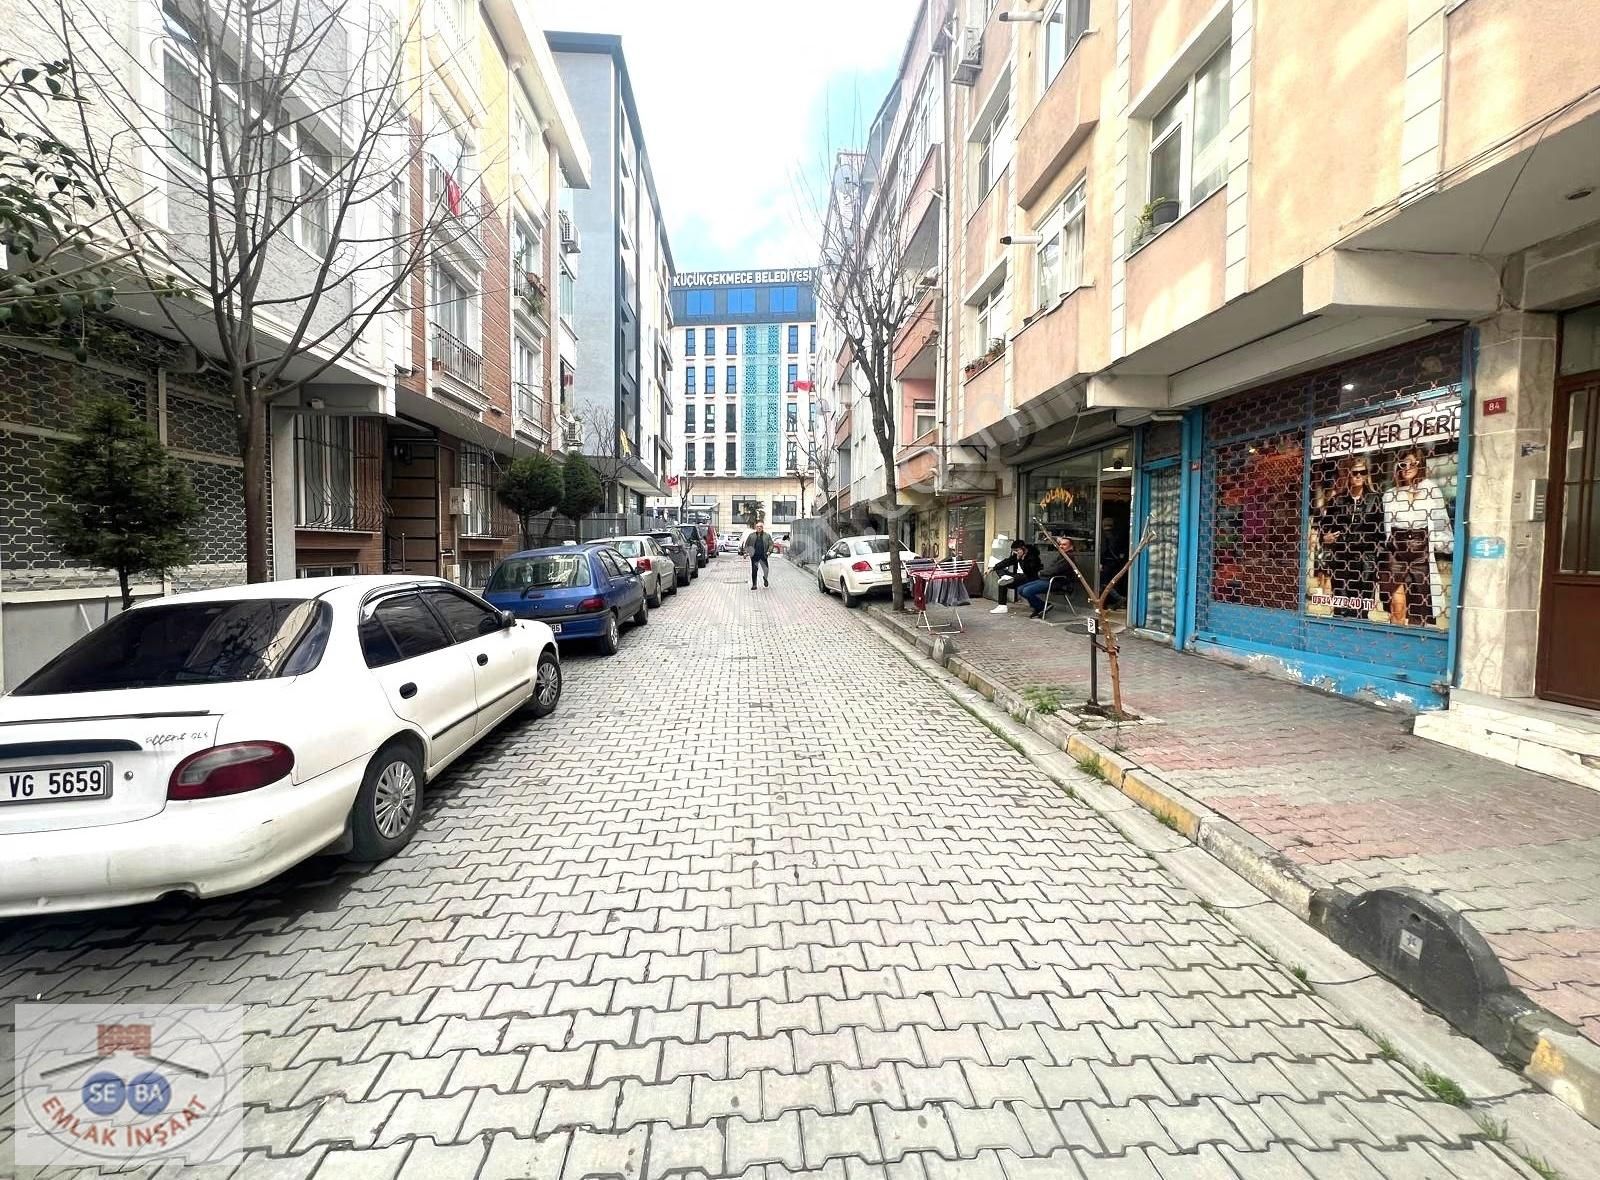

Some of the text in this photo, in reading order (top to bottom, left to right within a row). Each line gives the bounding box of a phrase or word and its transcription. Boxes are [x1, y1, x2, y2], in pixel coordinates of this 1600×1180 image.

[674, 271, 753, 287] KÜÇÜKÇEKMECE
[1489, 402, 1500, 411] 84
[1320, 424, 1401, 454] ERSEVER
[9, 770, 102, 798] VG 5659
